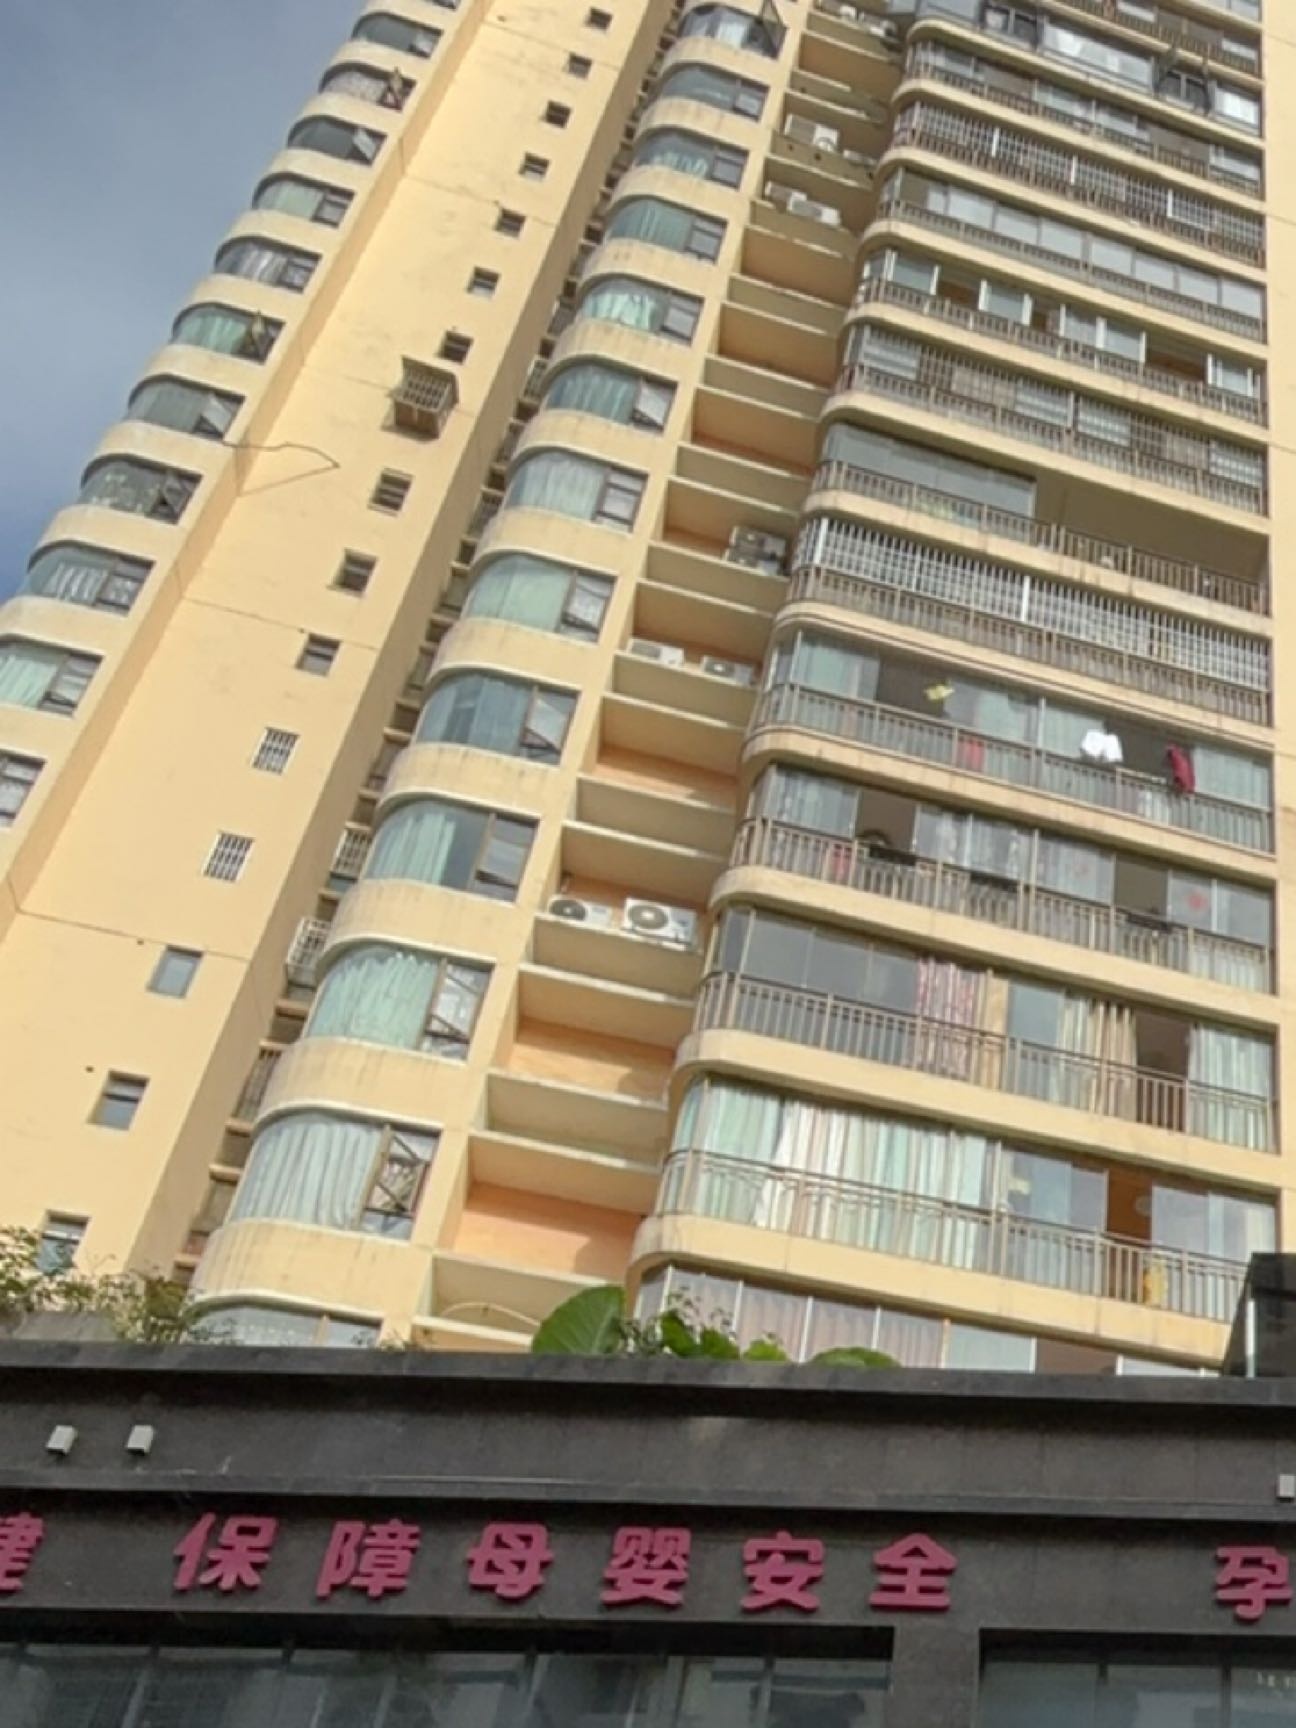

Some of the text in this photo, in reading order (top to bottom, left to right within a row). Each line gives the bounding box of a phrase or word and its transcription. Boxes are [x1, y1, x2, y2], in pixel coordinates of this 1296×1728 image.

[172, 1511, 958, 1612] 保障母婴安全
